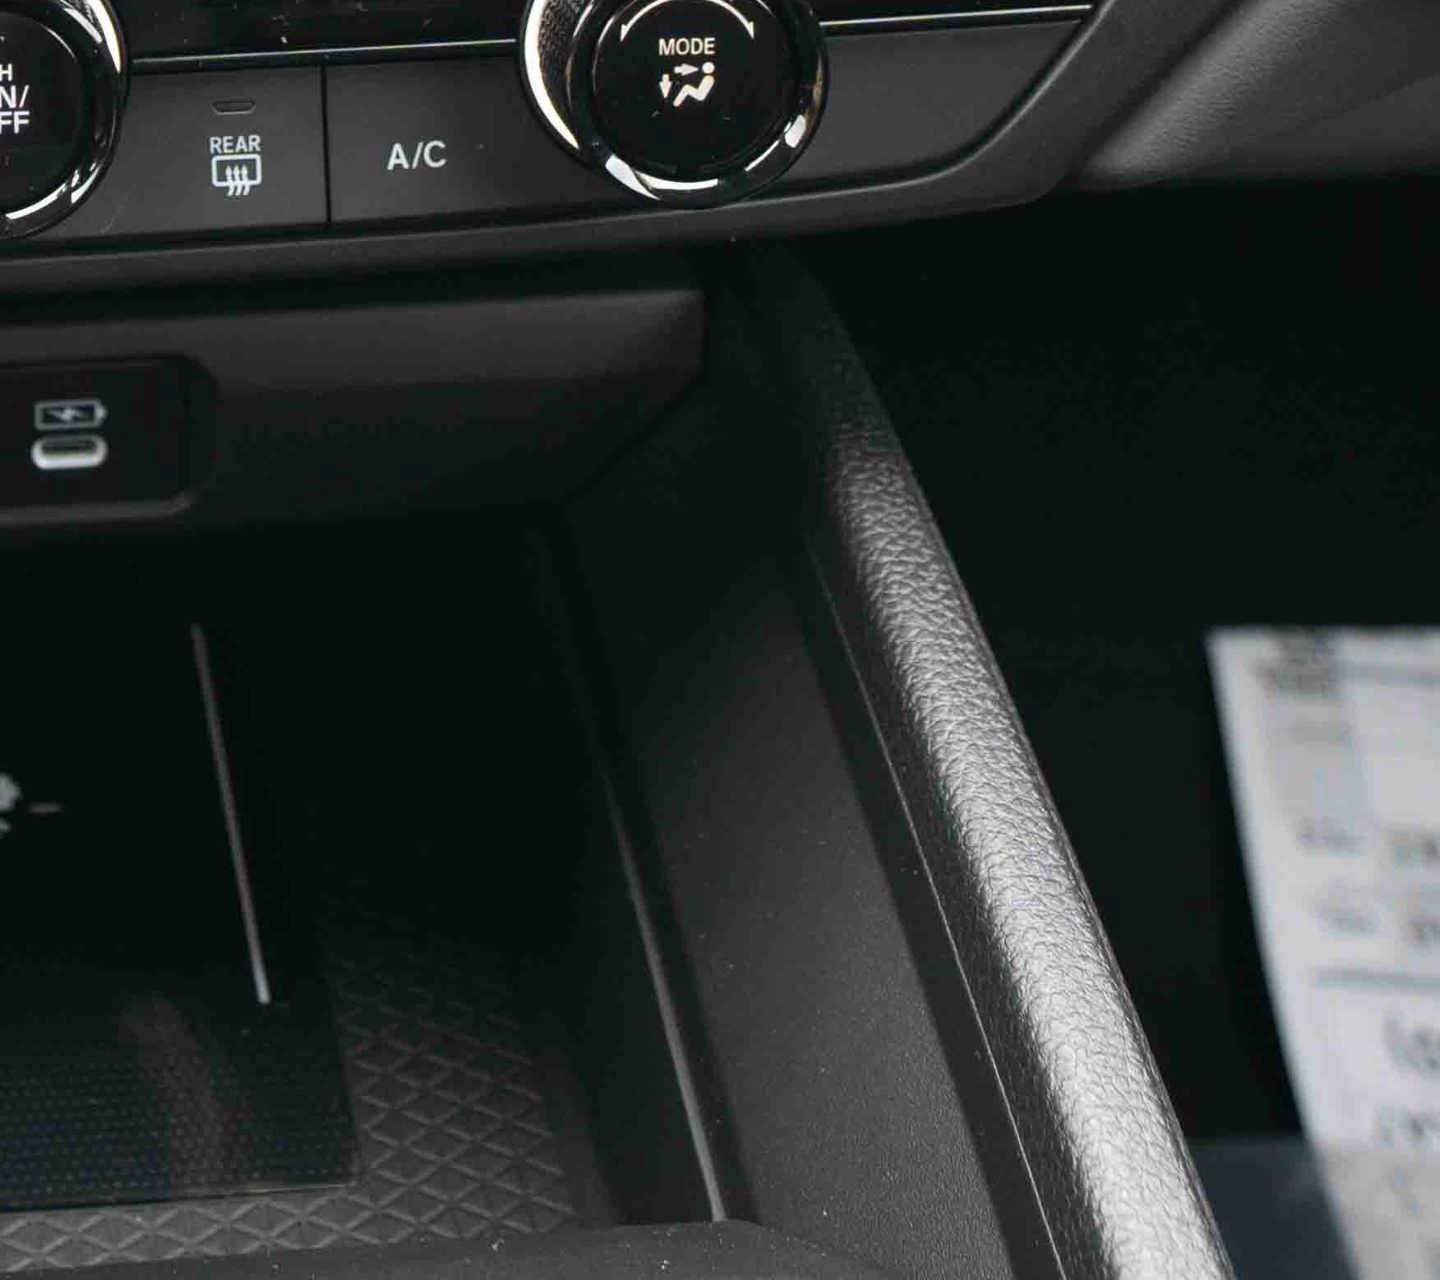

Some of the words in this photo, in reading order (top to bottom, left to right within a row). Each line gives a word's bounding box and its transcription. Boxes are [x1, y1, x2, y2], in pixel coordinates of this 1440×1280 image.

[658, 37, 716, 56] MODE
[209, 135, 262, 154] REAR
[386, 140, 447, 170] A/C
